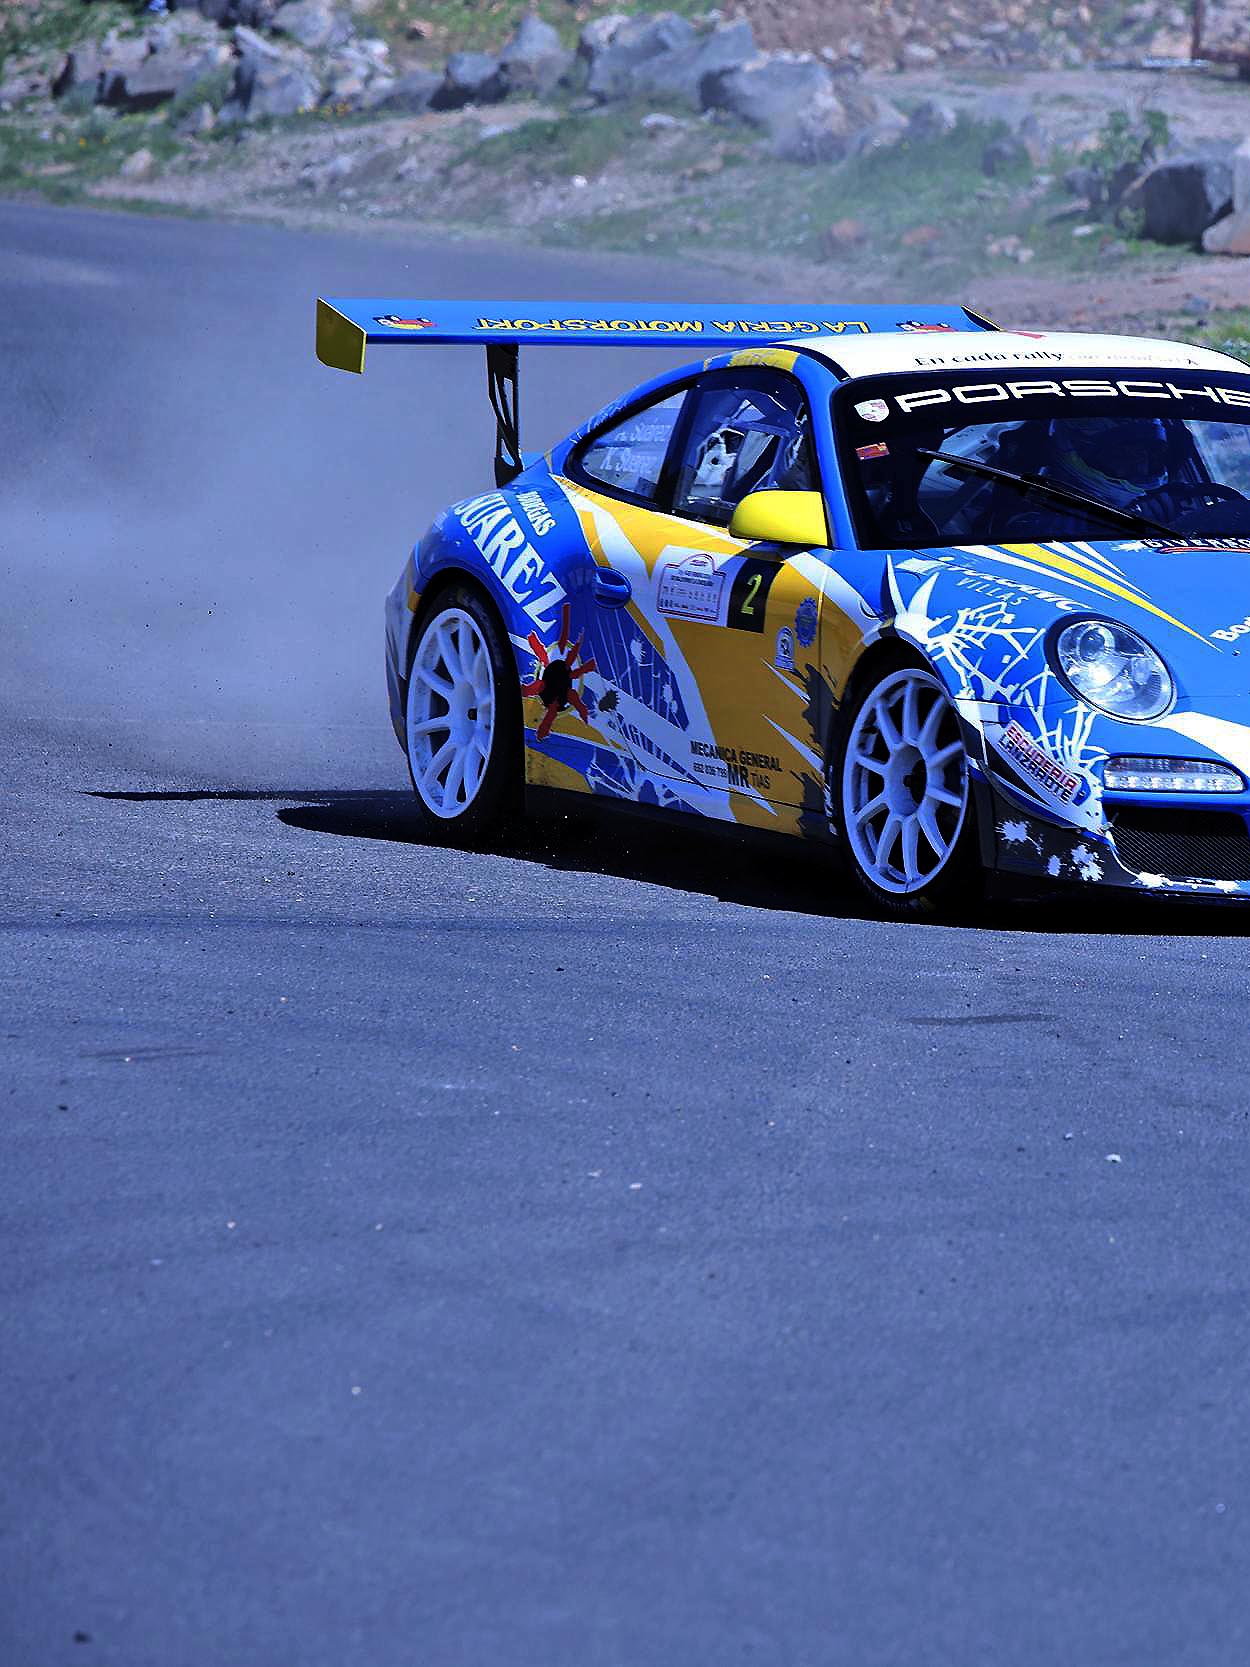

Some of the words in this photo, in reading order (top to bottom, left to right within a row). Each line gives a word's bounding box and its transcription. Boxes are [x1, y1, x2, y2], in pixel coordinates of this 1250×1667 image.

[473, 318, 705, 332] MOTORSPORT
[714, 319, 820, 333] GERIA
[822, 321, 870, 334] LA
[914, 355, 946, 367] En
[951, 351, 1007, 363] cada
[1012, 350, 1065, 362] rally
[740, 574, 762, 615] 2
[956, 576, 1030, 606] VILLAS
[690, 740, 738, 763] MECANICA
[740, 750, 784, 772] GENERAL
[997, 735, 1074, 802] LANZAROTE
[1006, 726, 1078, 791] ESCUDERIA
[727, 763, 751, 788] MR
